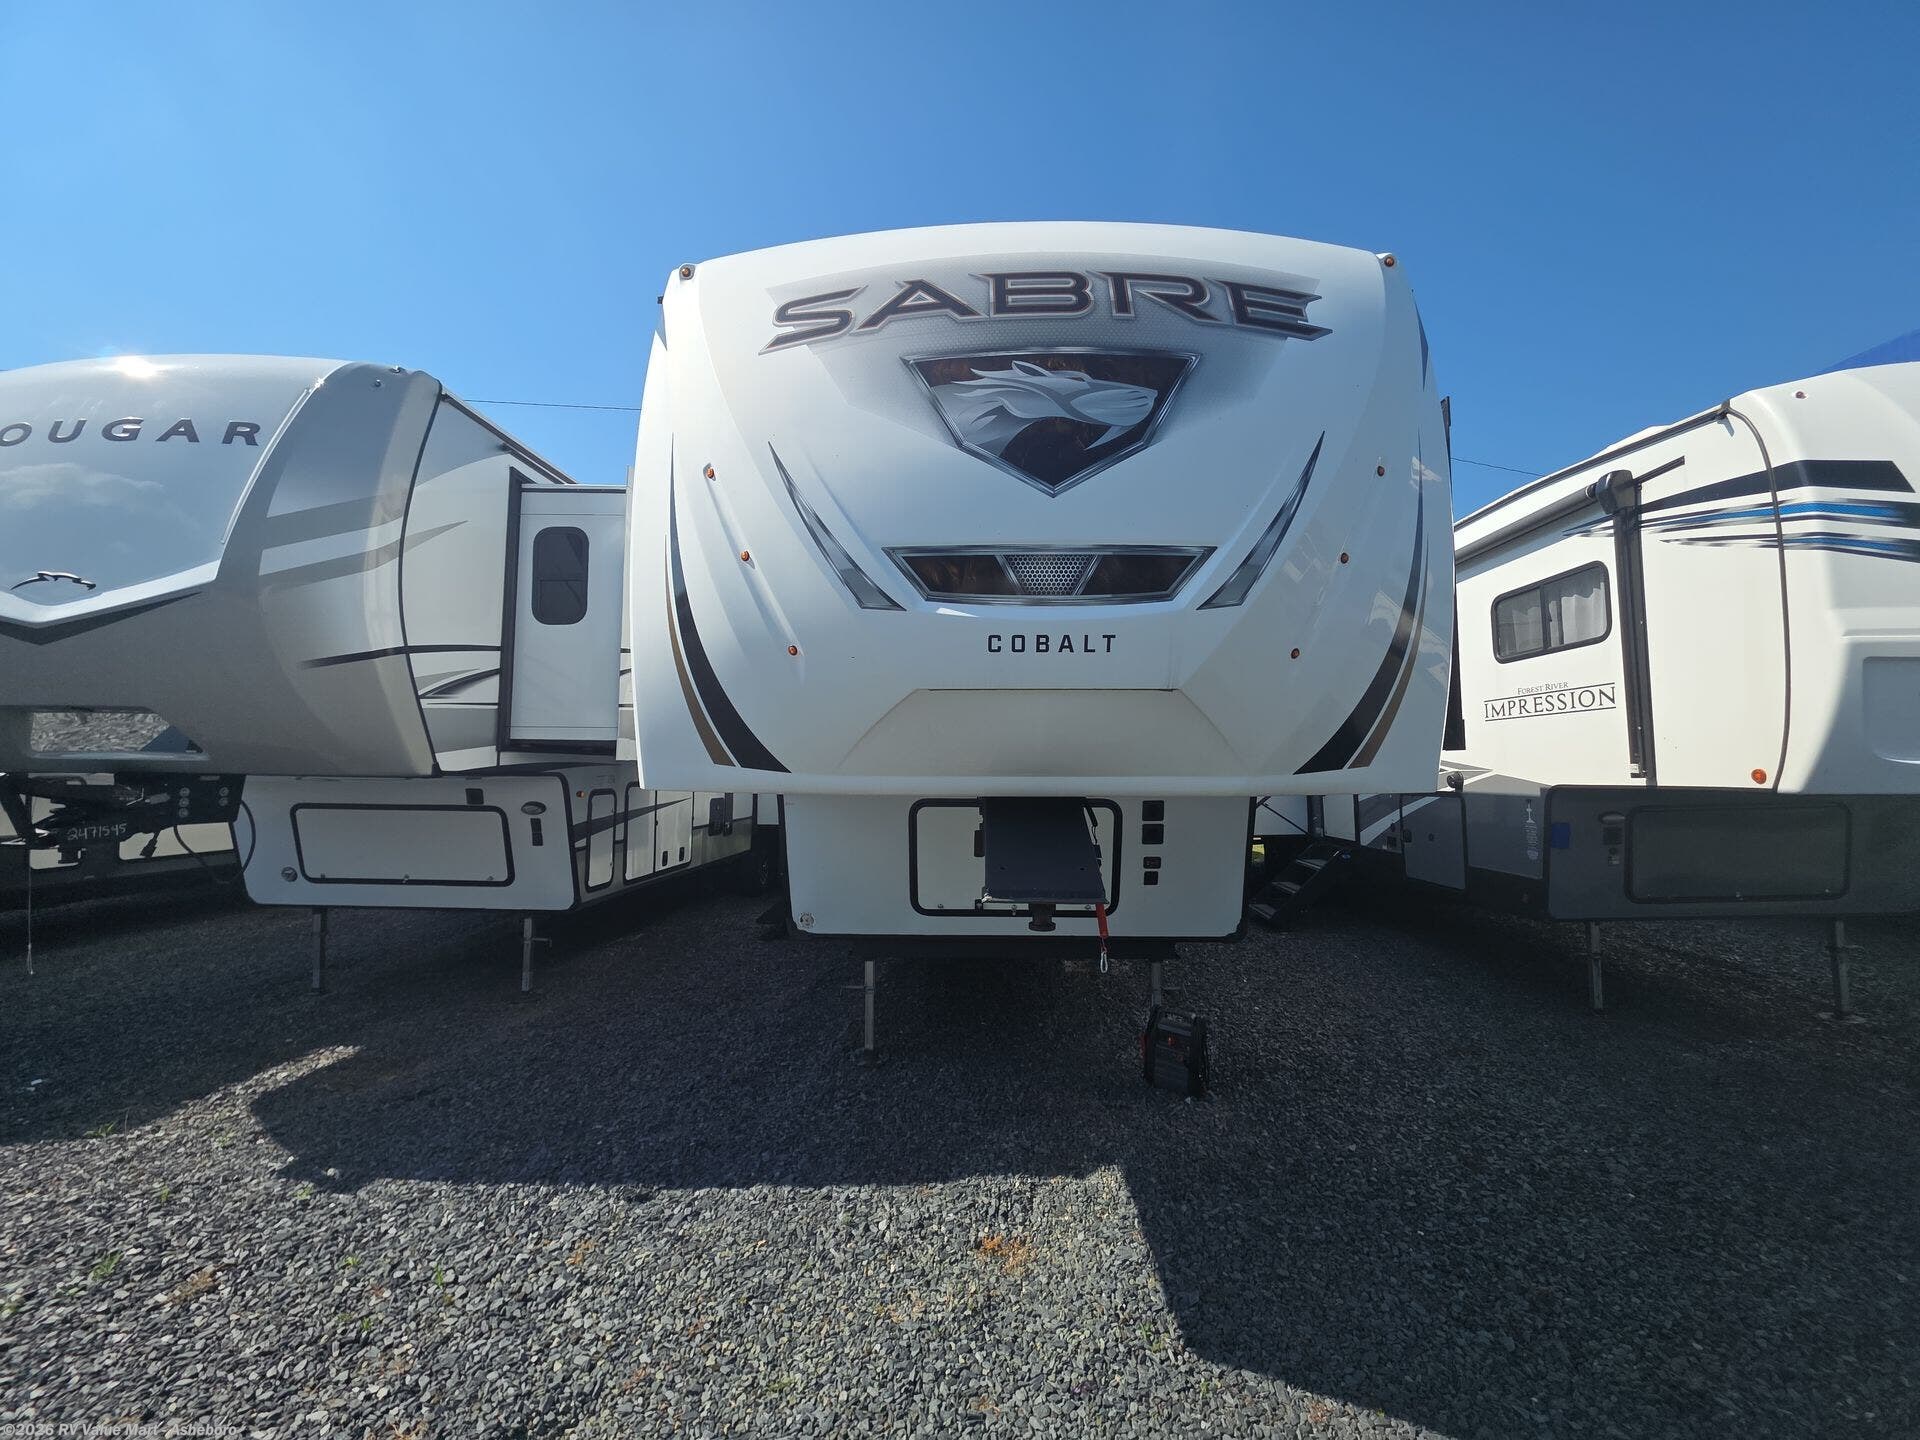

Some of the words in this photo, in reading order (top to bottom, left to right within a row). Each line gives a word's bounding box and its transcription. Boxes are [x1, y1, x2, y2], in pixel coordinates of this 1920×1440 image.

[758, 270, 1333, 355] SABRE
[987, 634, 1117, 653] COBALT
[1483, 686, 1616, 719] IMPRESSION
